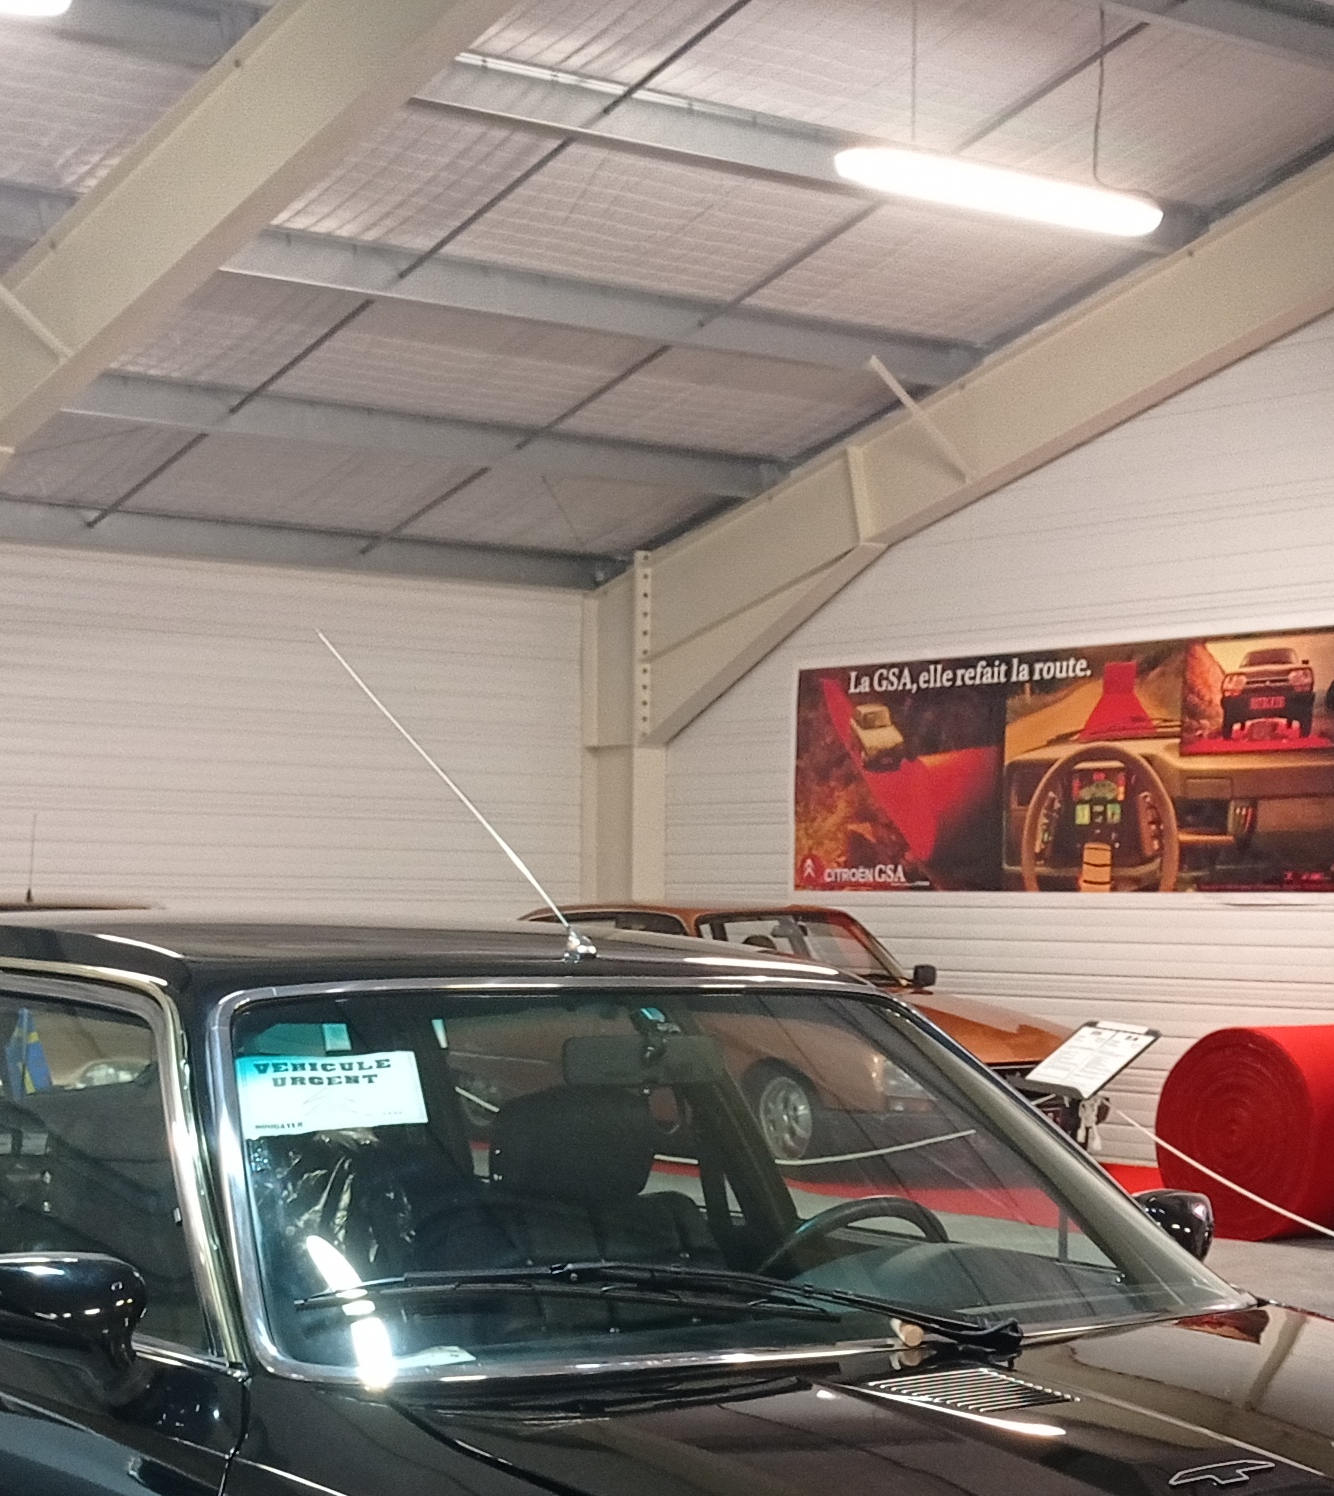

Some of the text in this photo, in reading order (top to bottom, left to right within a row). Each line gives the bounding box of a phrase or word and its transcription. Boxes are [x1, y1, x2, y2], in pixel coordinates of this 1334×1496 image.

[848, 657, 1092, 694] La GSA, elle refait la route.
[875, 864, 907, 883] GSA
[253, 1058, 392, 1075] VEHICULE
[271, 1073, 378, 1088] URGENT
